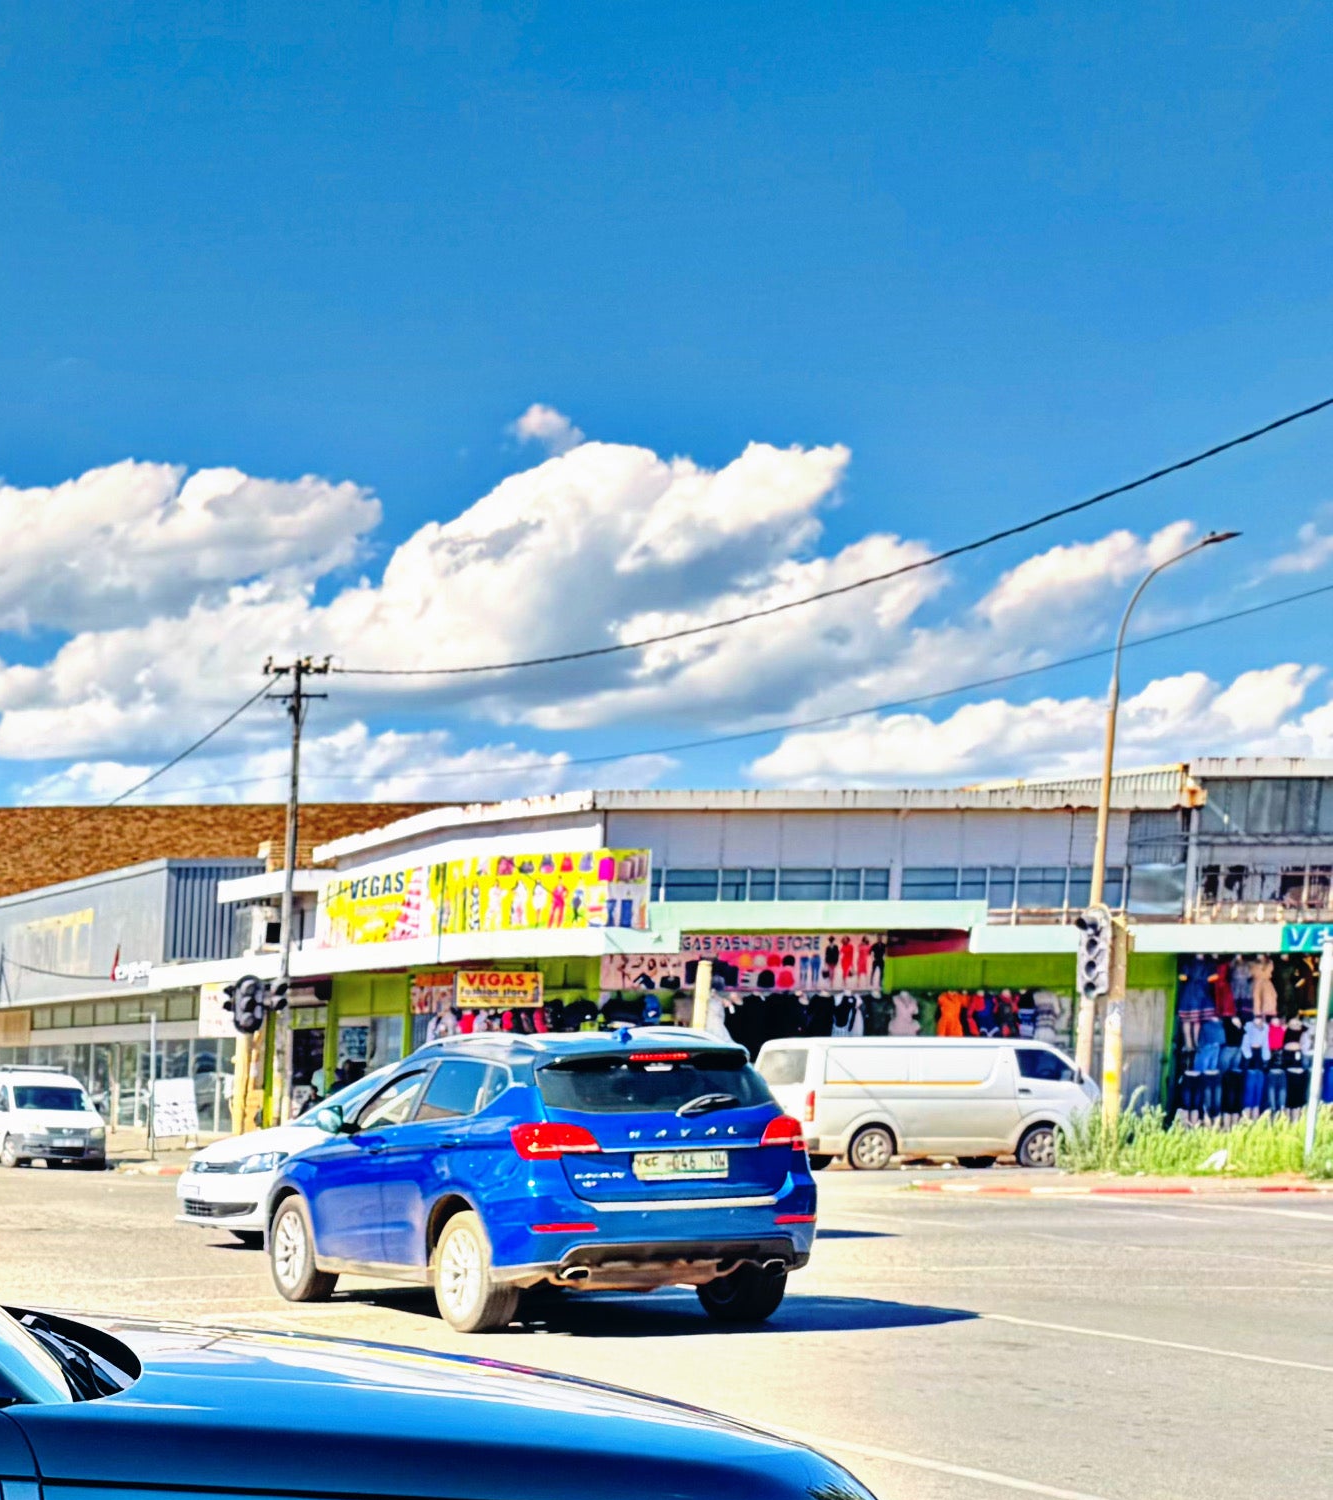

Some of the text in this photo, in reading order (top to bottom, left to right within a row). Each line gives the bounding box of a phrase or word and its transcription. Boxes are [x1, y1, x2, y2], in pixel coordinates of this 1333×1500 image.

[351, 871, 404, 899] VEGAS
[715, 936, 772, 951] FASHION
[777, 936, 821, 951] STORE
[465, 973, 525, 987] VEGAS
[629, 1126, 738, 1139] HAVAL
